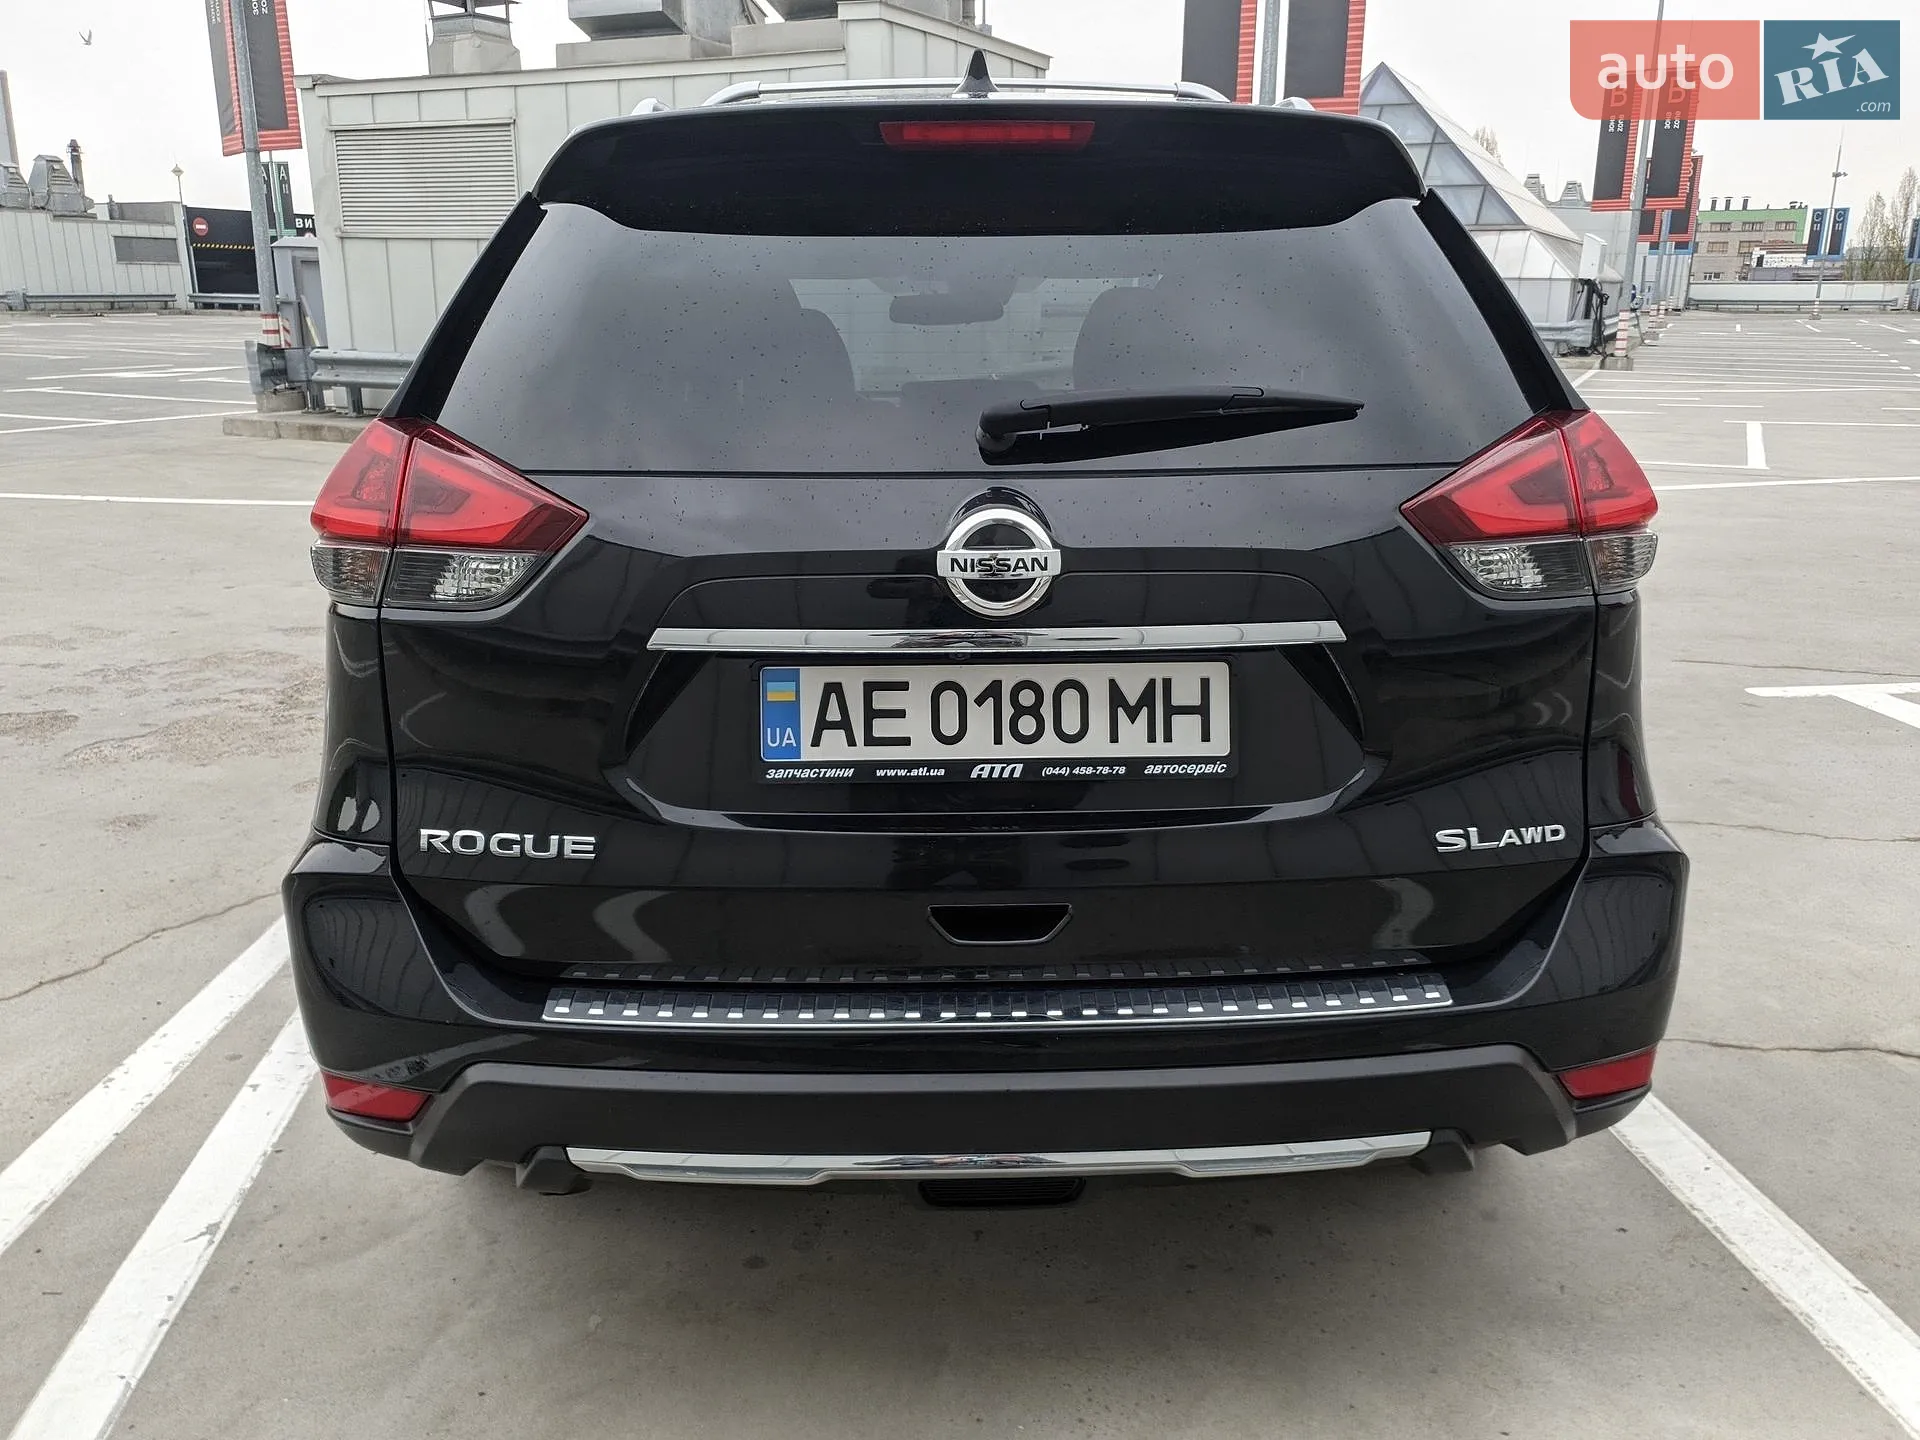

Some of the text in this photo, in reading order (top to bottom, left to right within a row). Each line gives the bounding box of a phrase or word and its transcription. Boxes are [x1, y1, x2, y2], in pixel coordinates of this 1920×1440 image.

[295, 216, 316, 229] ВИ
[950, 556, 1048, 573] NISSAN
[810, 677, 1211, 747] AE 0180 MH
[766, 727, 797, 747] UA
[765, 767, 855, 779] запчастини
[876, 766, 945, 777] www.atl.ua
[1041, 765, 1126, 777] (044) 458-78-78
[1144, 761, 1228, 777] автосервіс
[419, 828, 597, 860] ROGUE
